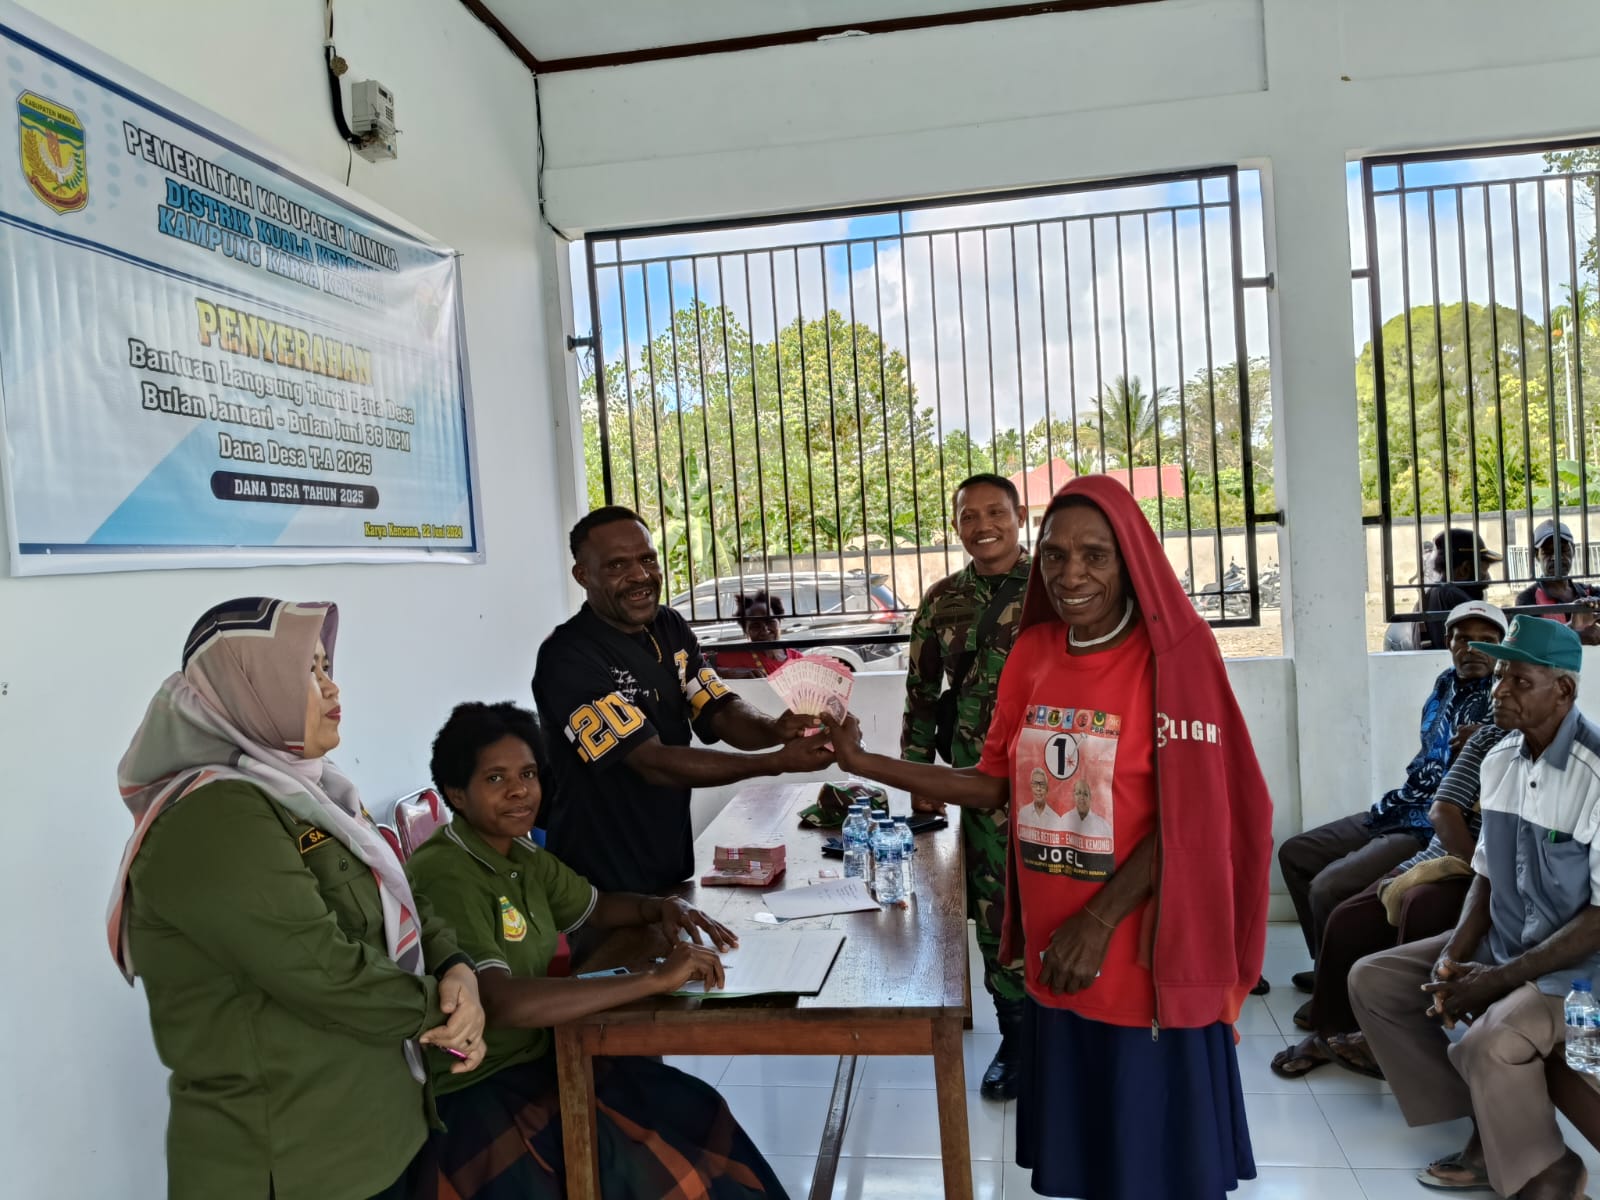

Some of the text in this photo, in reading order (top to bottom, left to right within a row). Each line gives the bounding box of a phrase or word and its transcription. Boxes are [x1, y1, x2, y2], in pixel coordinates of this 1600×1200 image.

[123, 120, 254, 209] PEMERINTAH
[256, 185, 347, 250] KABUPATEN
[348, 229, 400, 272] MIMIKA
[165, 177, 253, 238] DISTRIK
[255, 217, 314, 262] KUALA
[158, 204, 261, 267] KAMPUNG
[266, 247, 320, 290] KARYA
[195, 297, 373, 386] PENYERAHAN
[128, 338, 415, 425] Bantuan Langsung Tunai Dana Desa
[141, 381, 206, 419] Bulan
[208, 394, 274, 431] Januari
[288, 409, 333, 440] Bulan
[334, 418, 364, 444] Juni
[366, 424, 383, 448] 36
[385, 428, 411, 451] KPM
[218, 432, 373, 475] Dana Desa T.A 2025
[234, 479, 364, 503] DANA DESA TAHUN 2025
[364, 521, 387, 540] Karya
[569, 690, 645, 762] 20
[1053, 738, 1067, 776] 1
[1038, 847, 1084, 868] JOEL
